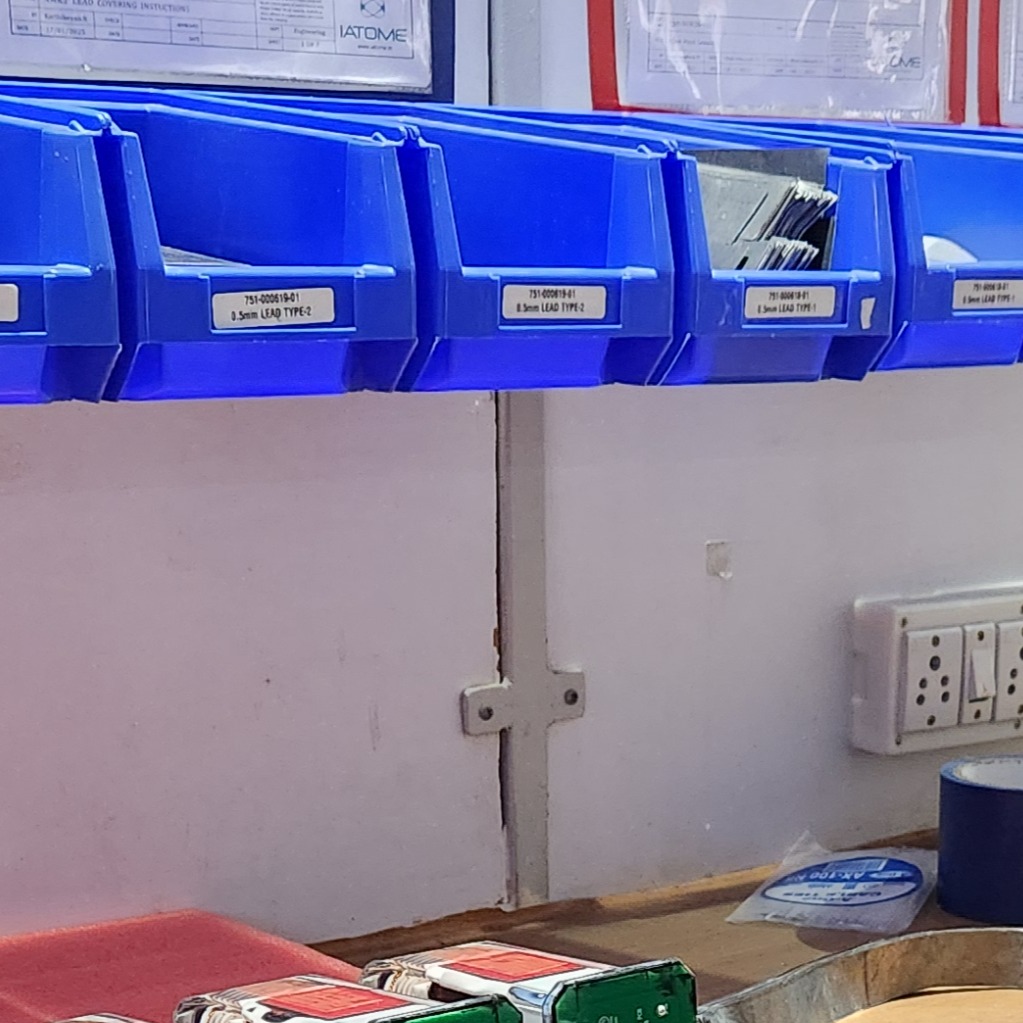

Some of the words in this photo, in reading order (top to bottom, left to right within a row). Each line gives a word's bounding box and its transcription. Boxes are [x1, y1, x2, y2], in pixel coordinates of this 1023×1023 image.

[340, 25, 407, 42] IATOME
[244, 293, 300, 305] 751-000619-01
[529, 289, 576, 299] 751-000619-01
[516, 303, 540, 312] 0.5mm
[541, 303, 559, 312] LEAD
[562, 303, 585, 312] TYPE-2
[779, 304, 794, 313] LEAD
[796, 303, 816, 312] TYPE-1
[231, 310, 258, 321] 0.5mm
[260, 308, 281, 320] LEAD
[284, 306, 312, 318] TYPE-2
